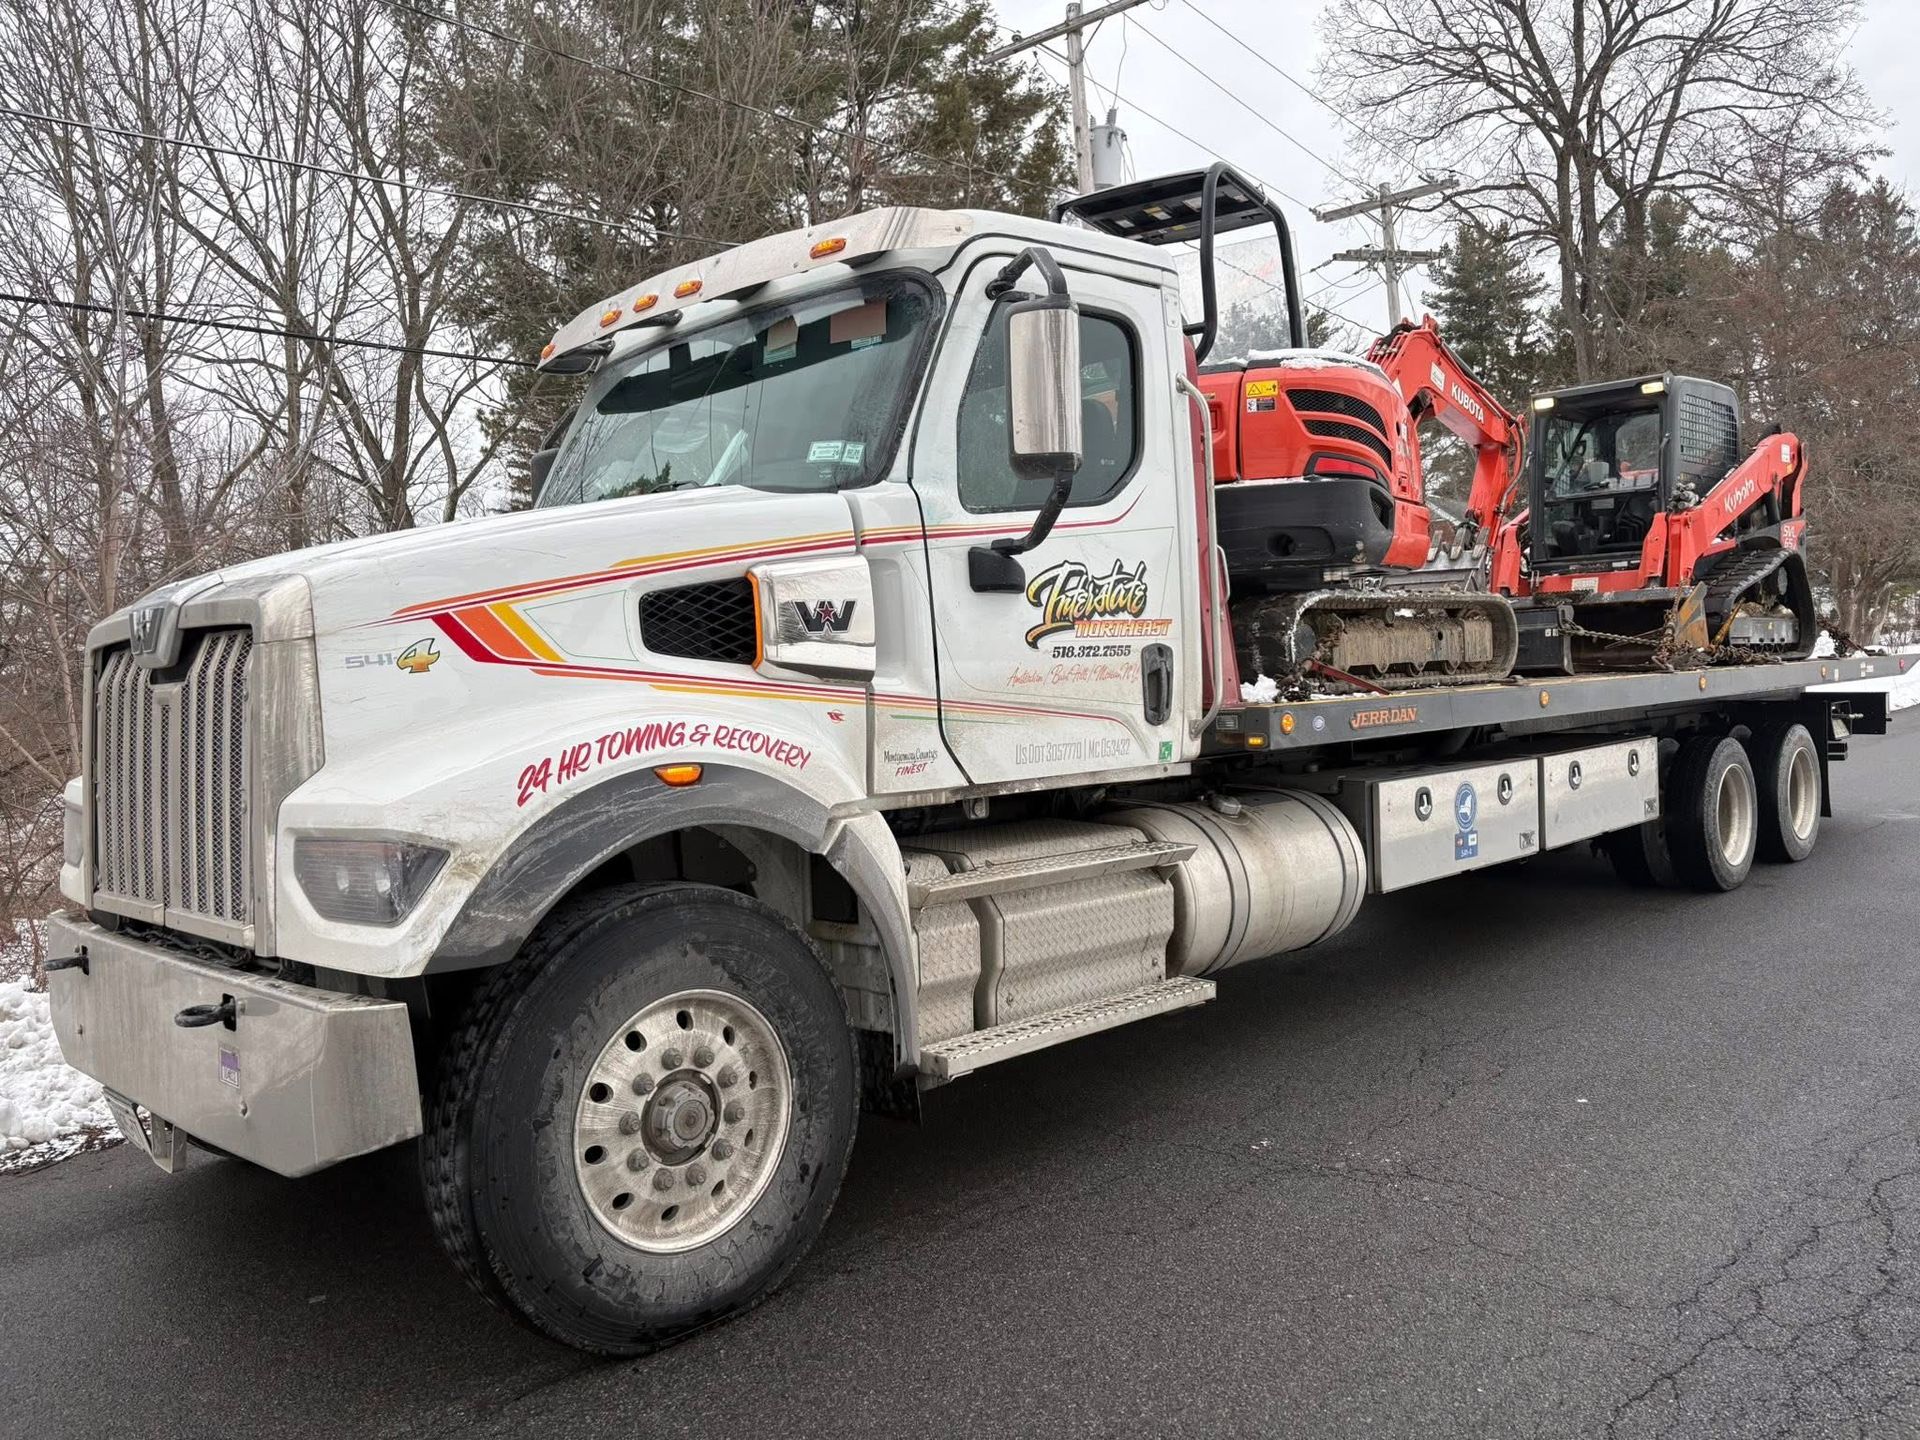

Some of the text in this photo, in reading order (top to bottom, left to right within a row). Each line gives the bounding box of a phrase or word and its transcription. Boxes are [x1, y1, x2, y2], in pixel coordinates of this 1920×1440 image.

[1451, 382, 1484, 424] KUBOTA
[1724, 478, 1755, 513] Kubota
[1026, 559, 1147, 649] Interstate
[1074, 618, 1173, 638] NORTHEAST
[1052, 645, 1131, 659] 518.372.7555
[517, 721, 811, 807] 24 HR TOWING & RECOVERY
[895, 762, 928, 777] FINEST
